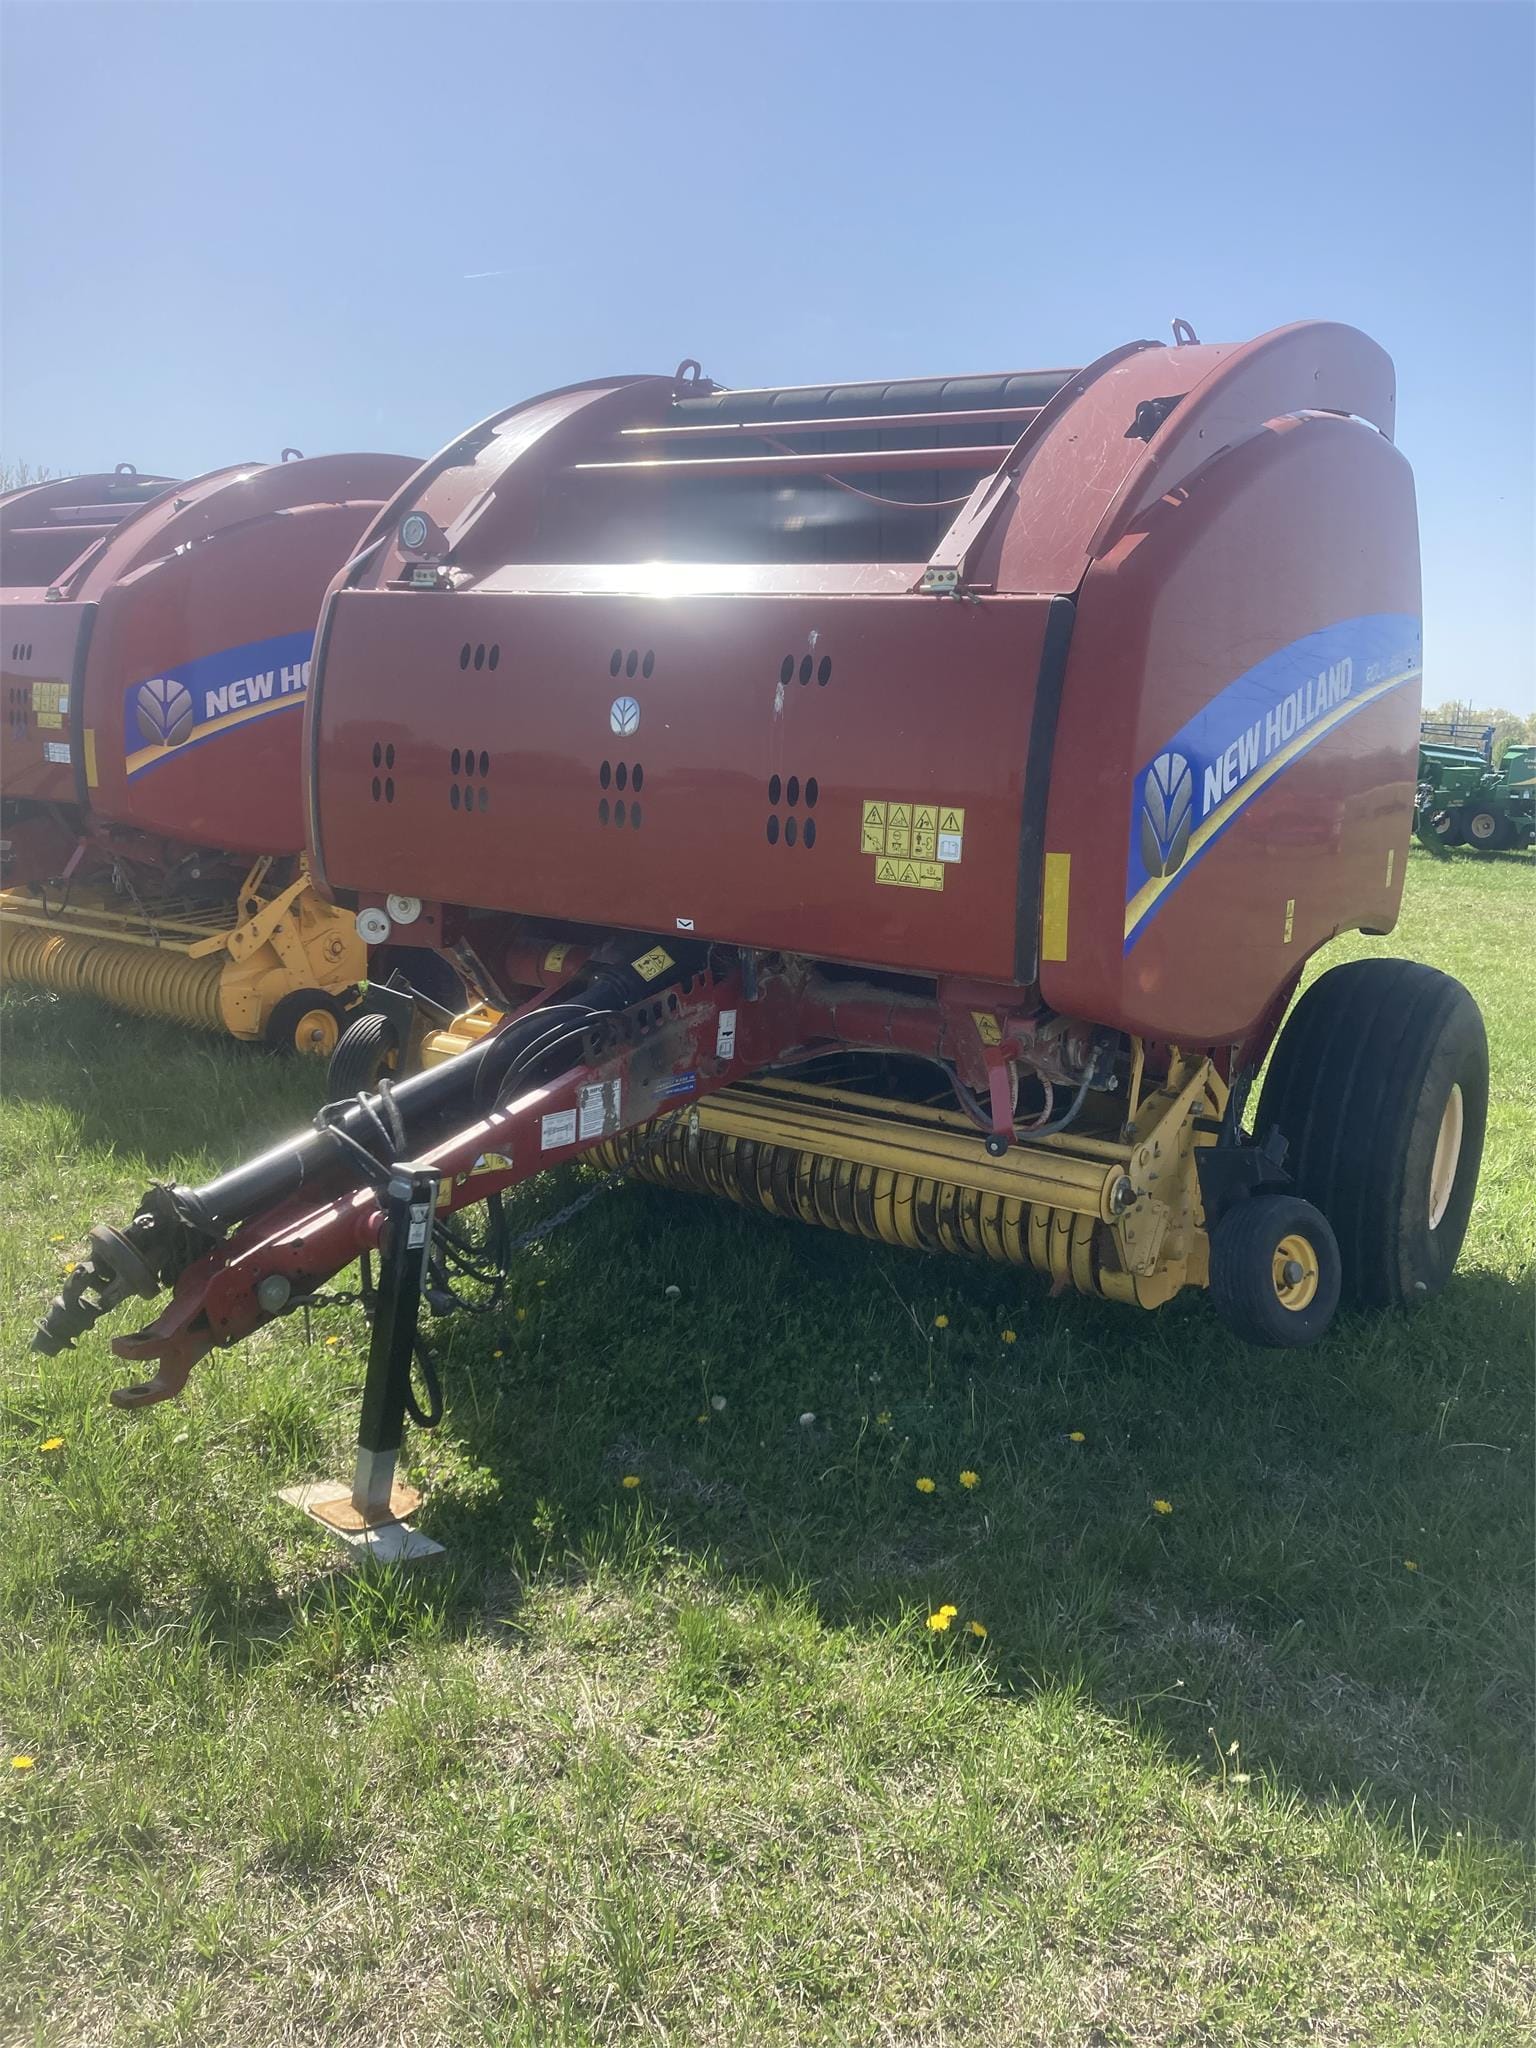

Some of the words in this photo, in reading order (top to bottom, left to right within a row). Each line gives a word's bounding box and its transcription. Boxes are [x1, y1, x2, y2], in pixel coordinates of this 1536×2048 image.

[206, 671, 274, 718] NEW
[1202, 720, 1261, 816] NEW
[1264, 656, 1353, 757] HOLLAND
